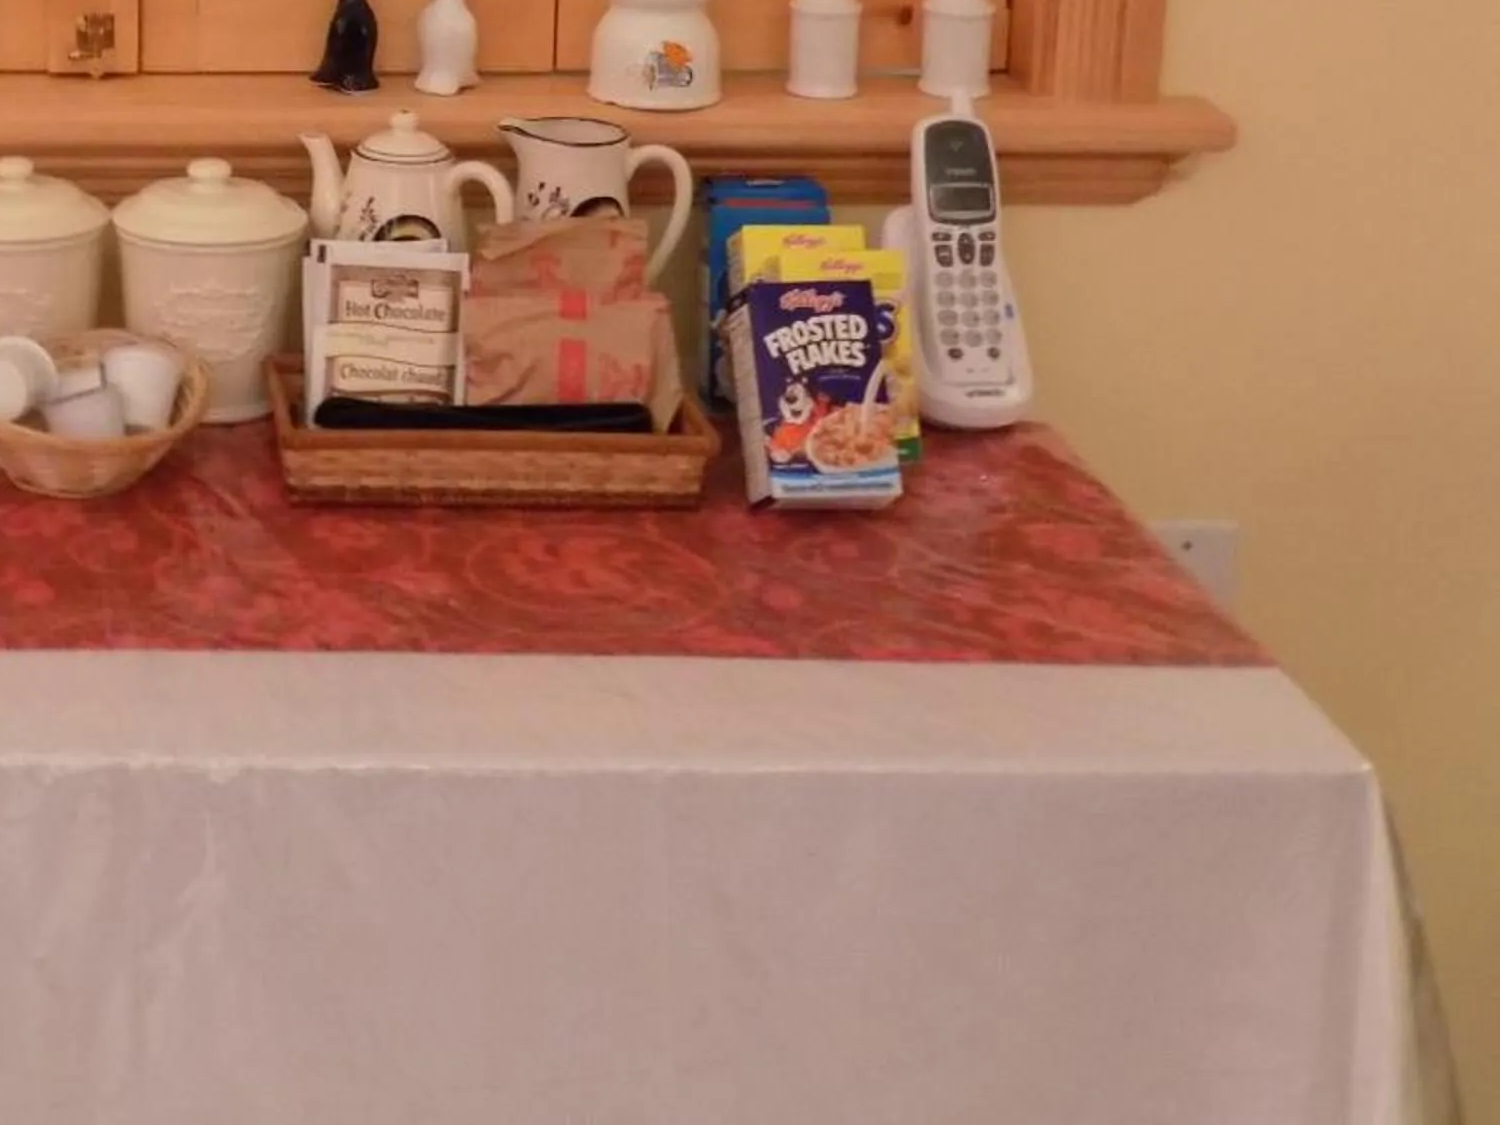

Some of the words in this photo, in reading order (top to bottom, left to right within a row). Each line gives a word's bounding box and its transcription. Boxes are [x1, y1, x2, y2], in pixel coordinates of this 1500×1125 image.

[345, 300, 371, 317] Hot
[374, 302, 446, 321] Chocolate
[763, 314, 869, 359] FROSTED
[785, 340, 867, 374] FLAKES
[340, 363, 398, 381] Chocolat
